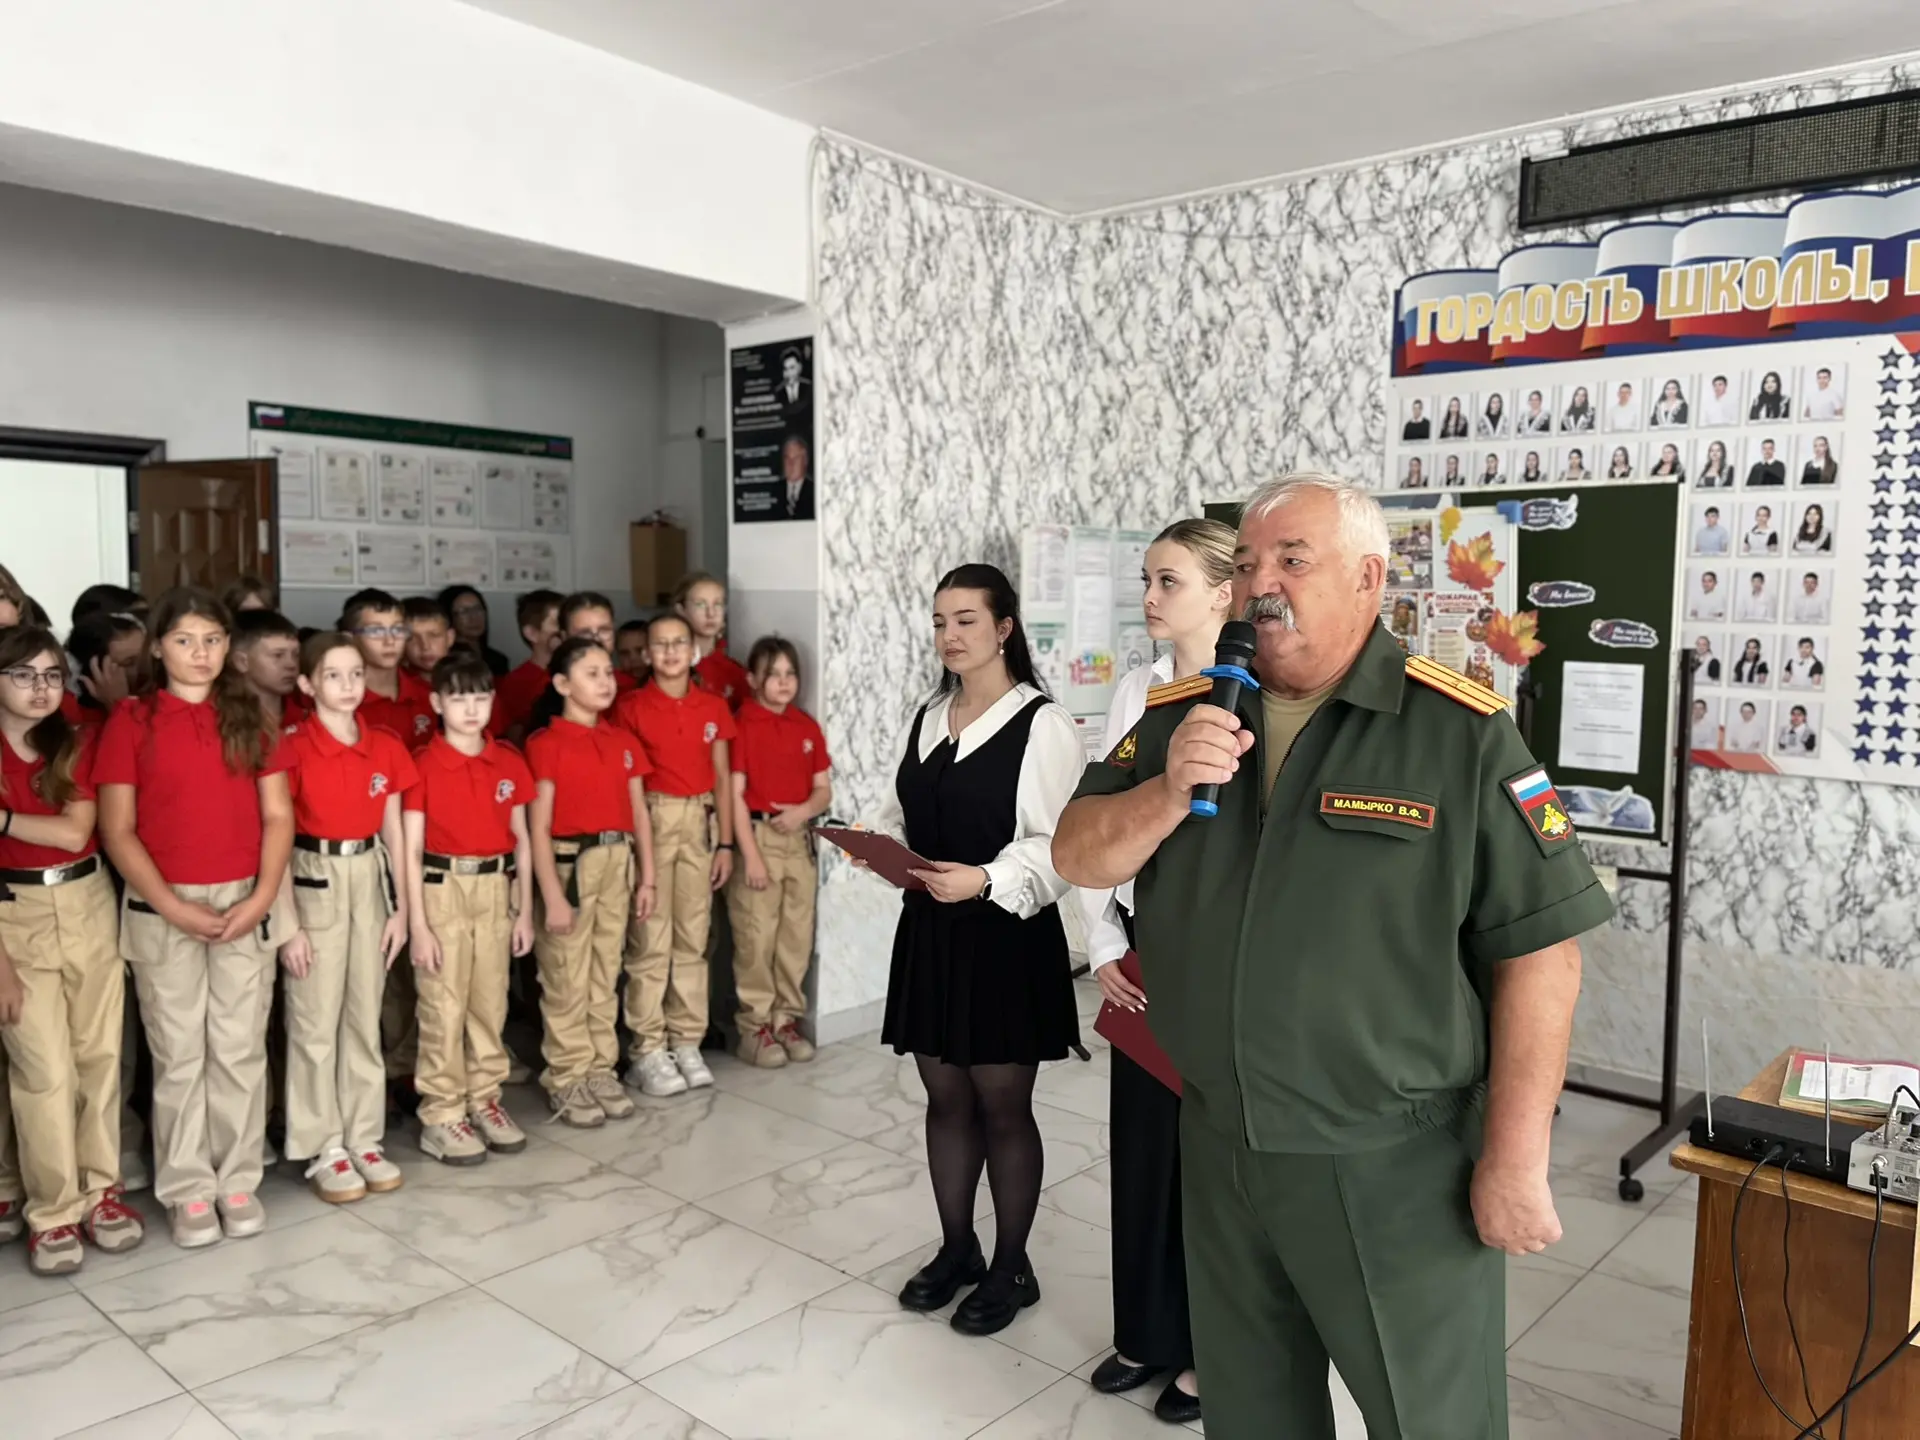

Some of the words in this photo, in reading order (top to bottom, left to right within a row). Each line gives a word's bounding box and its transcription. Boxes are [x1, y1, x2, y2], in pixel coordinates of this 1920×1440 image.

[1415, 272, 1644, 346] ГОРДОСТЬ
[1655, 244, 1890, 320] ШКОЛЫ,
[1333, 798, 1394, 813] МАМЫРКО
[1398, 806, 1422, 819] В.Ф.
